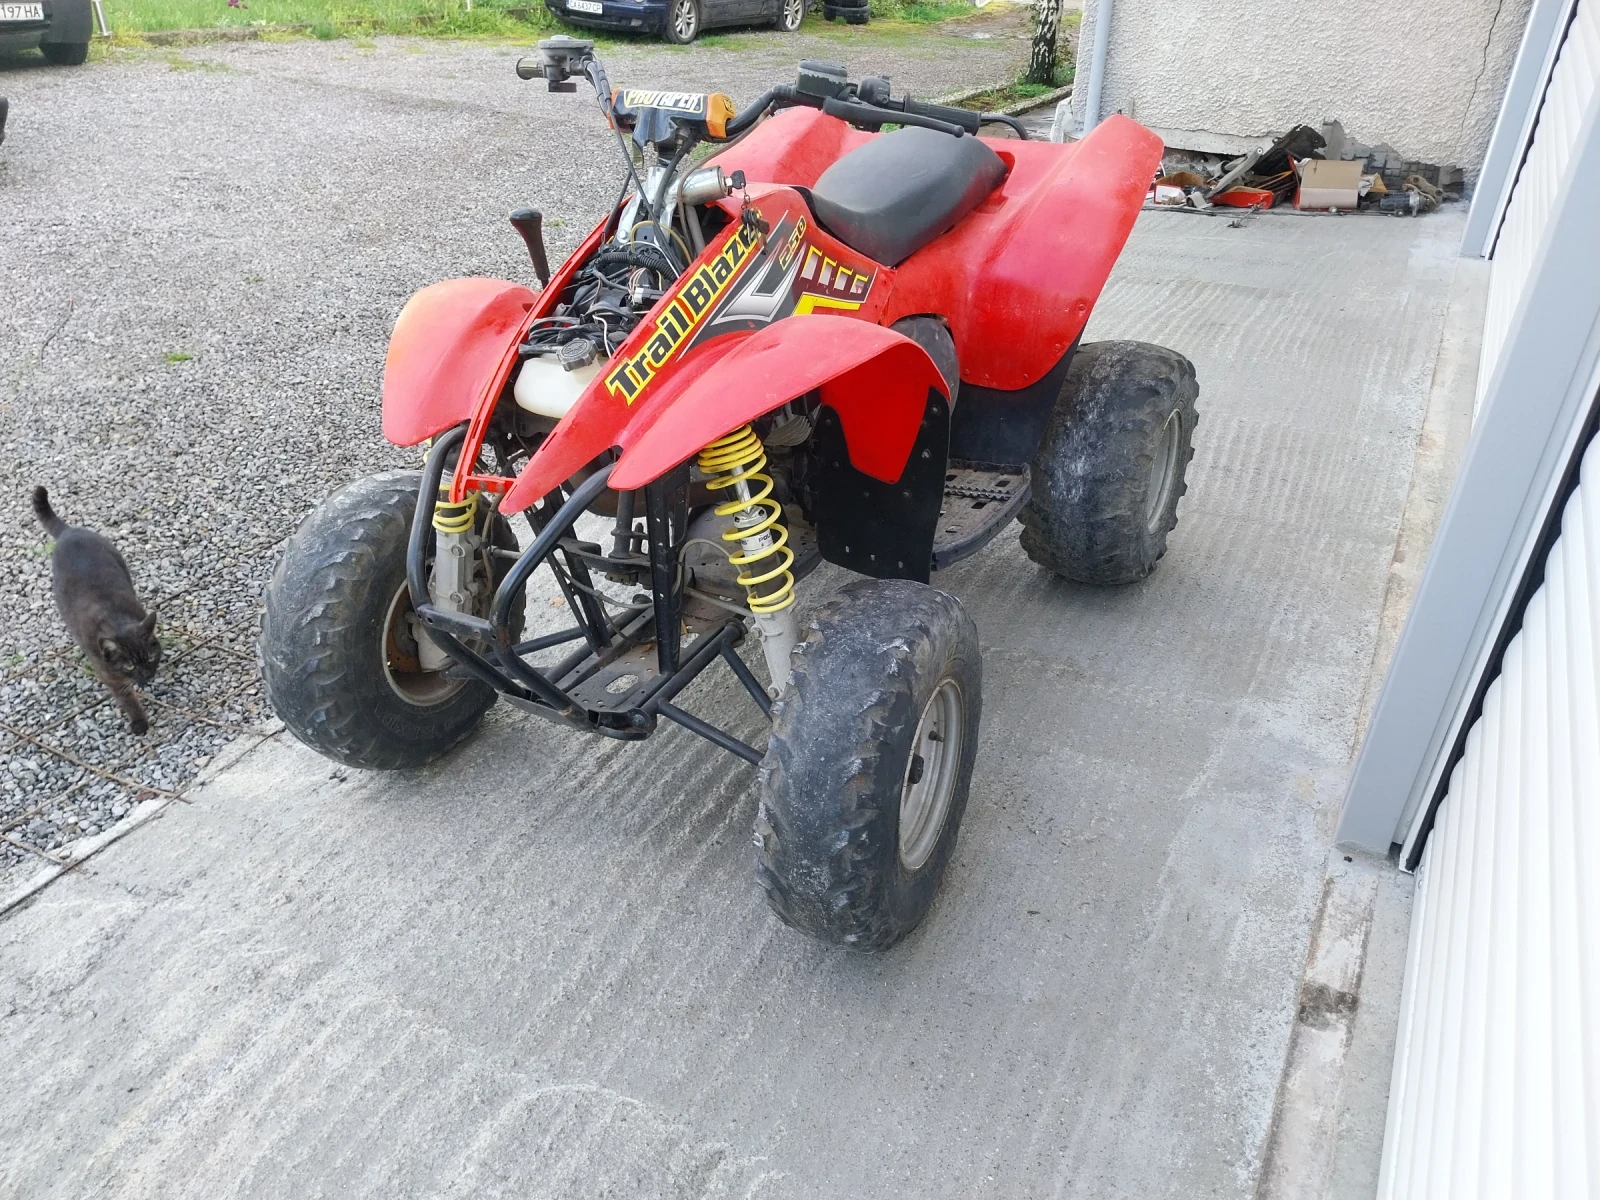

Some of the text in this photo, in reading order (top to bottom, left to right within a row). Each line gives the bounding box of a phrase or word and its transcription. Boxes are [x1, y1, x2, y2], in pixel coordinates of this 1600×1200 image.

[24, 5, 40, 18] HA
[626, 89, 701, 112] PROTAPER
[604, 298, 695, 406] Trail
